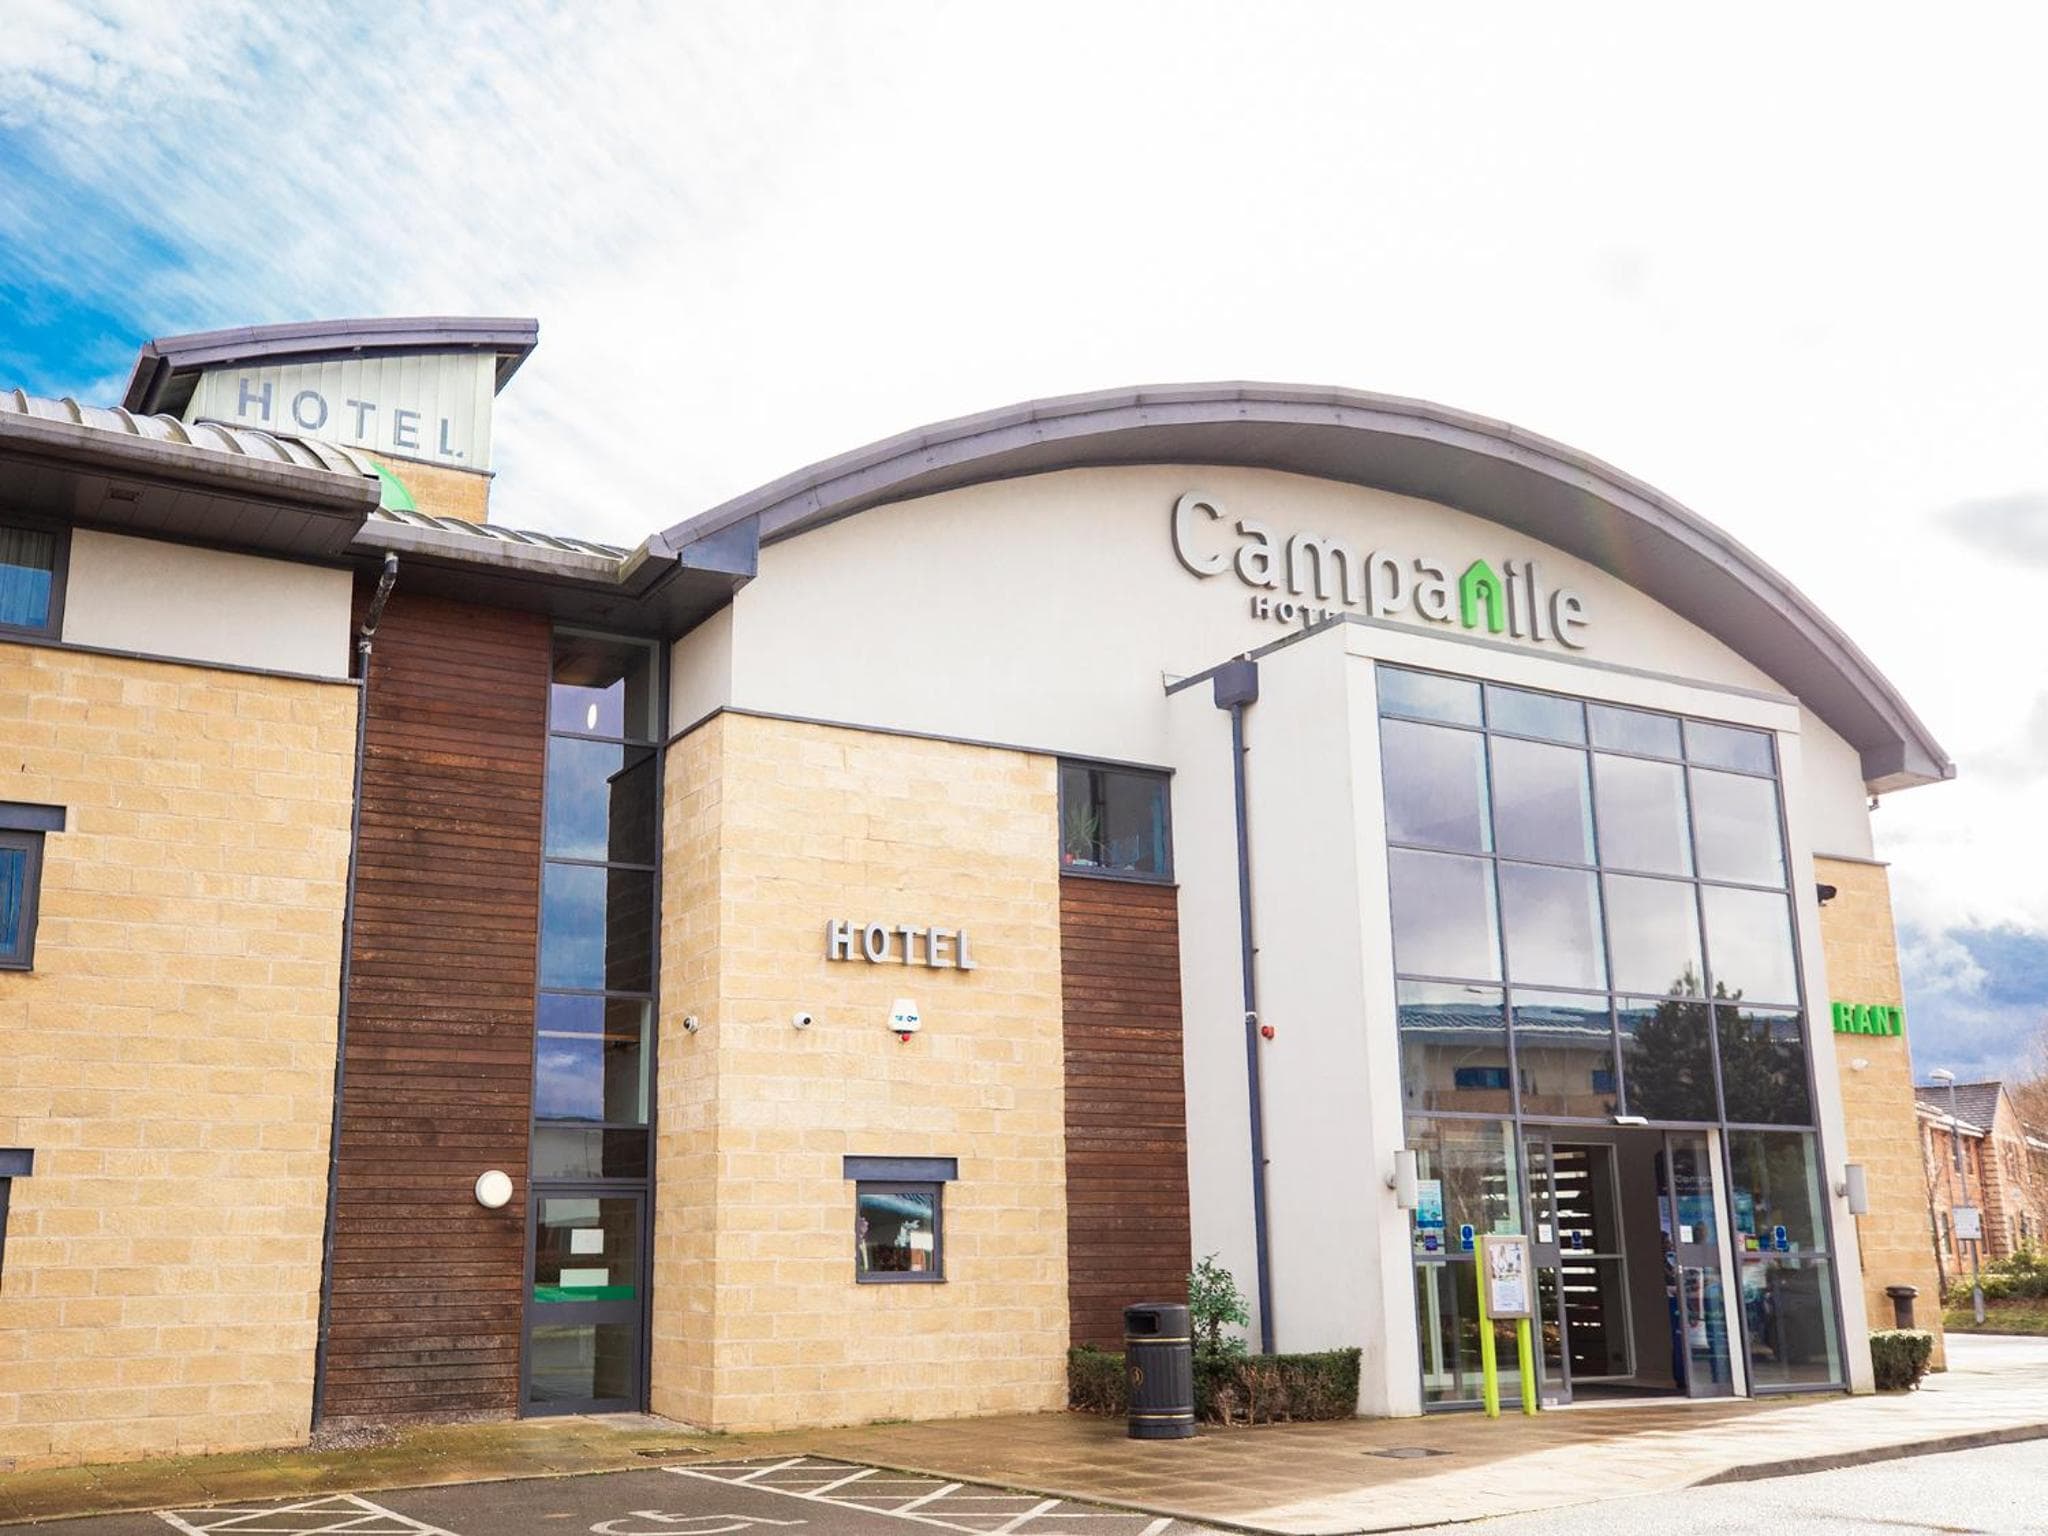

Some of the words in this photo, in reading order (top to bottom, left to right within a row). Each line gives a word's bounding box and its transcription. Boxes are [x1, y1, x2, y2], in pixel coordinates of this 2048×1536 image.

[238, 377, 464, 459] HOTEL
[1171, 491, 1590, 649] Campanile
[826, 919, 977, 972] HOTEL
